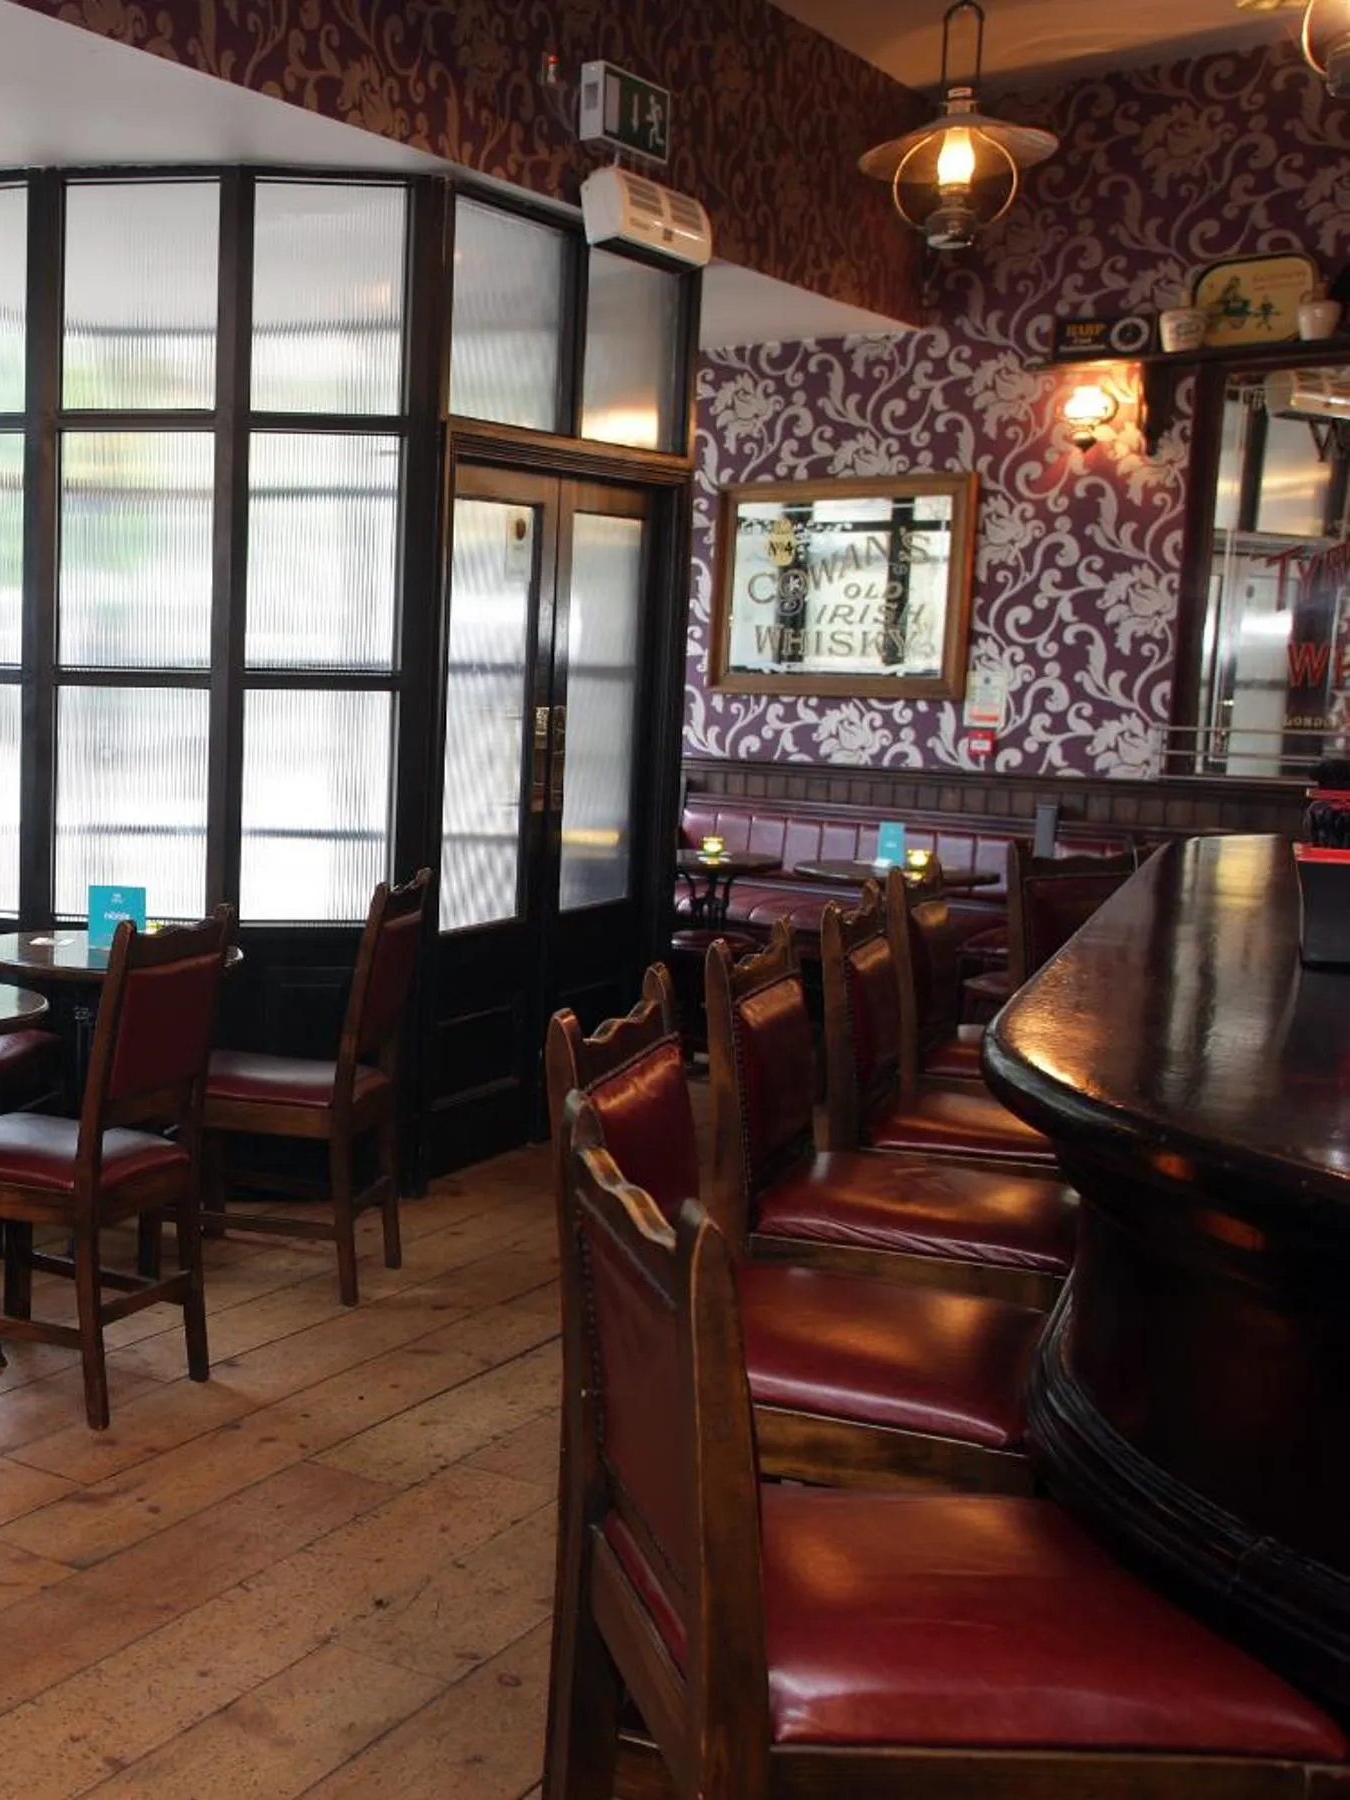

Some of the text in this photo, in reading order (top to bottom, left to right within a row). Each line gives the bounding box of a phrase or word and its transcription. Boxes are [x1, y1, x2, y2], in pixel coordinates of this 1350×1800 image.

[843, 582, 903, 600] OLD
[815, 603, 925, 625] IRISH
[755, 624, 918, 658] WHISKY
